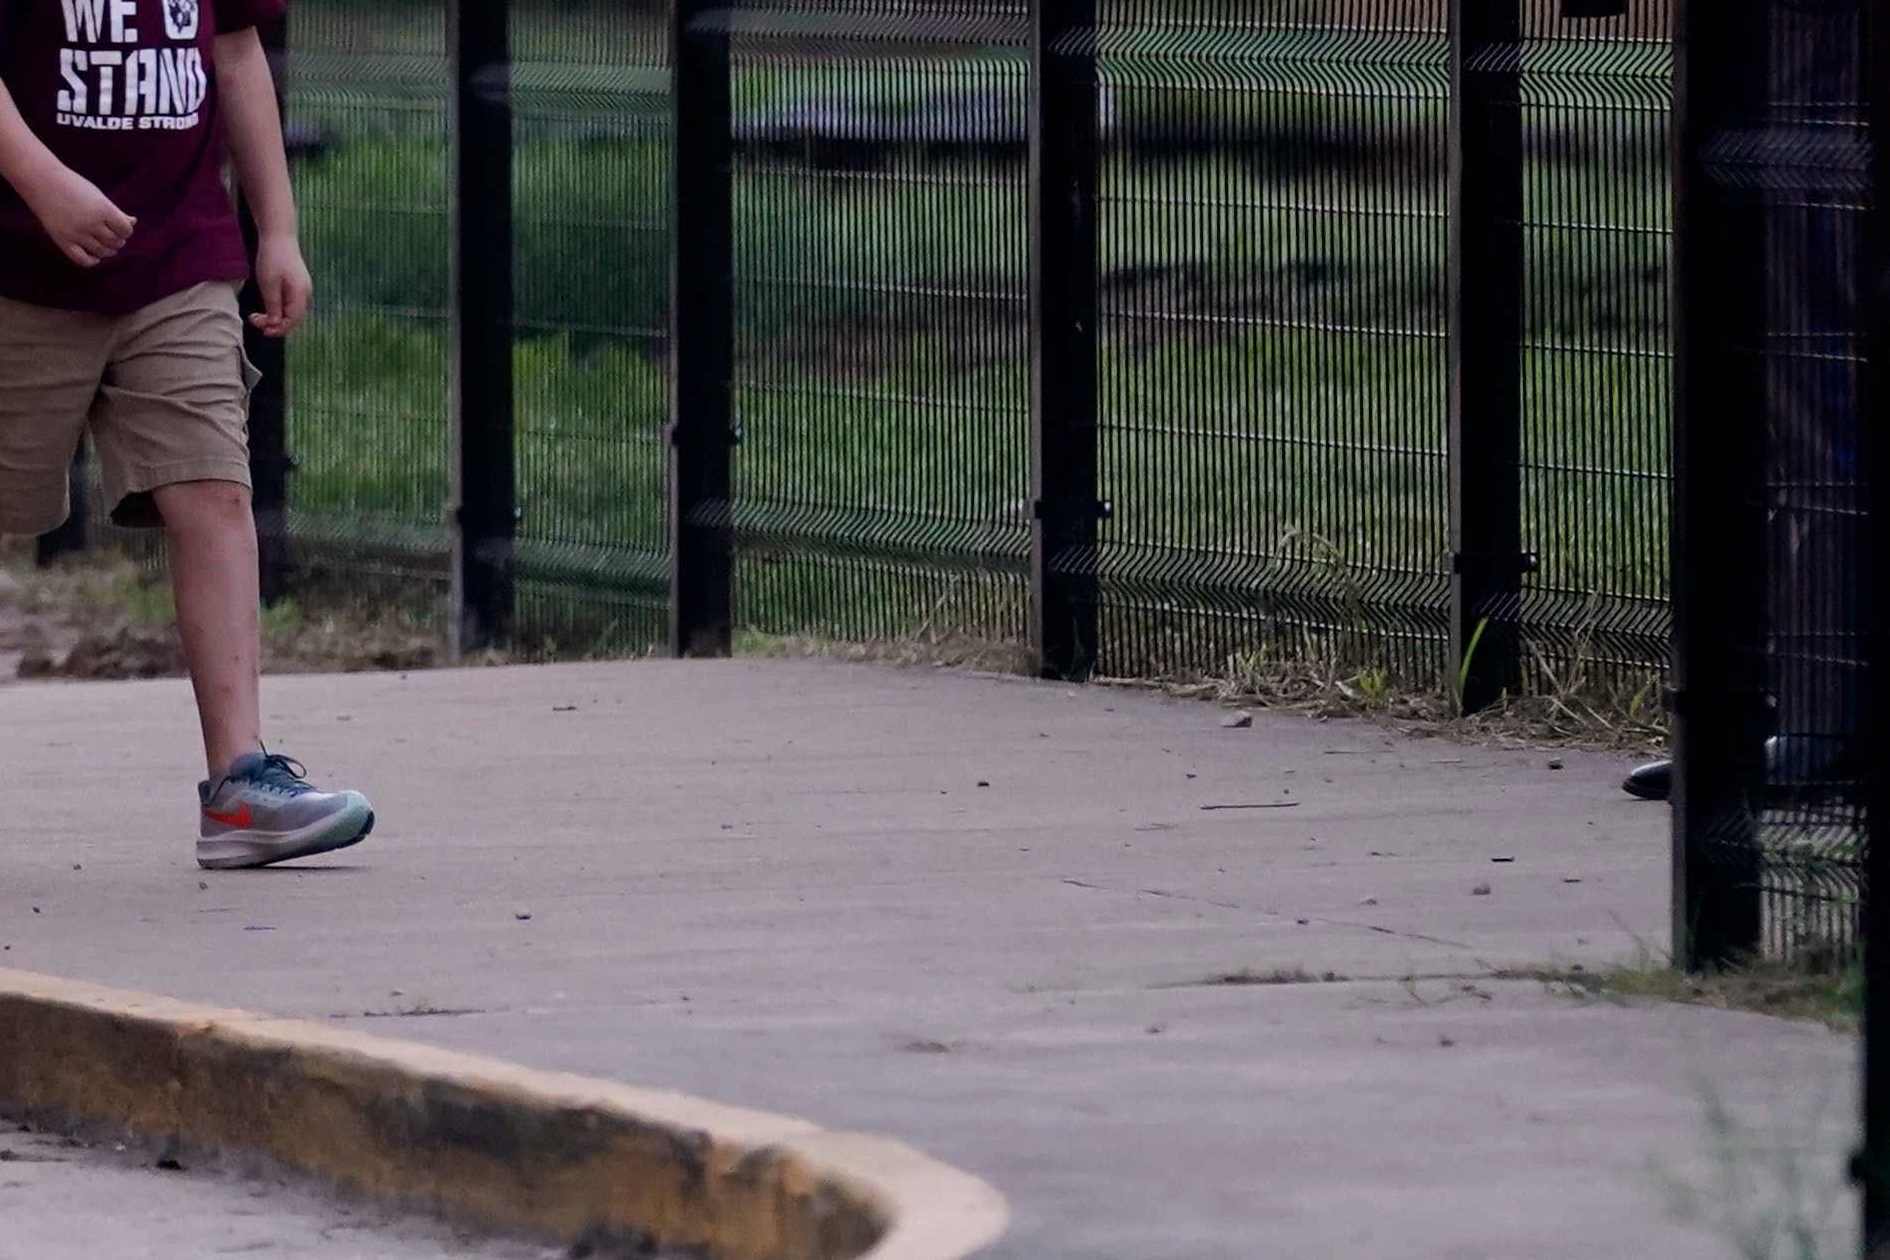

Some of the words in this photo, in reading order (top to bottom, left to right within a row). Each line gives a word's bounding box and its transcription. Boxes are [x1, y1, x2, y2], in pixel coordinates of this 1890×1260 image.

[57, 47, 207, 115] STAND
[56, 112, 135, 131] UVALDE
[137, 112, 199, 130] STRO
